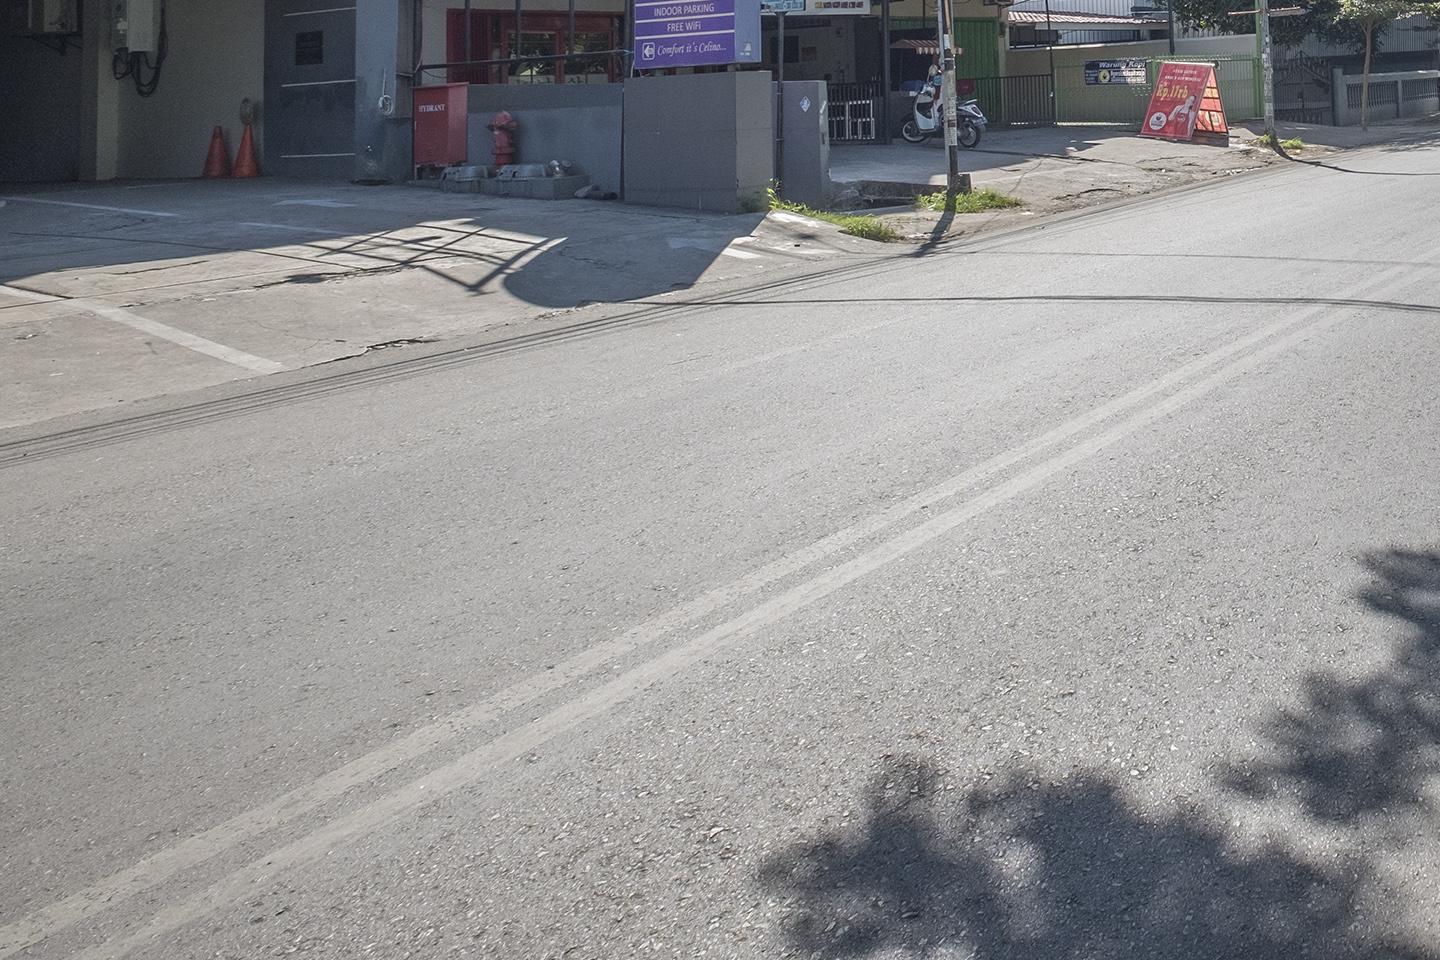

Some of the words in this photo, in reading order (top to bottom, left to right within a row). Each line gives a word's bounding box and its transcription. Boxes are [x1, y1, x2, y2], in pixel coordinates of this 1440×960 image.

[654, 6, 682, 17] INDOOR
[683, 3, 715, 15] PARKING
[667, 23, 683, 32] FREE
[657, 43, 685, 57] Comfort
[418, 103, 446, 113] HYDRANT
